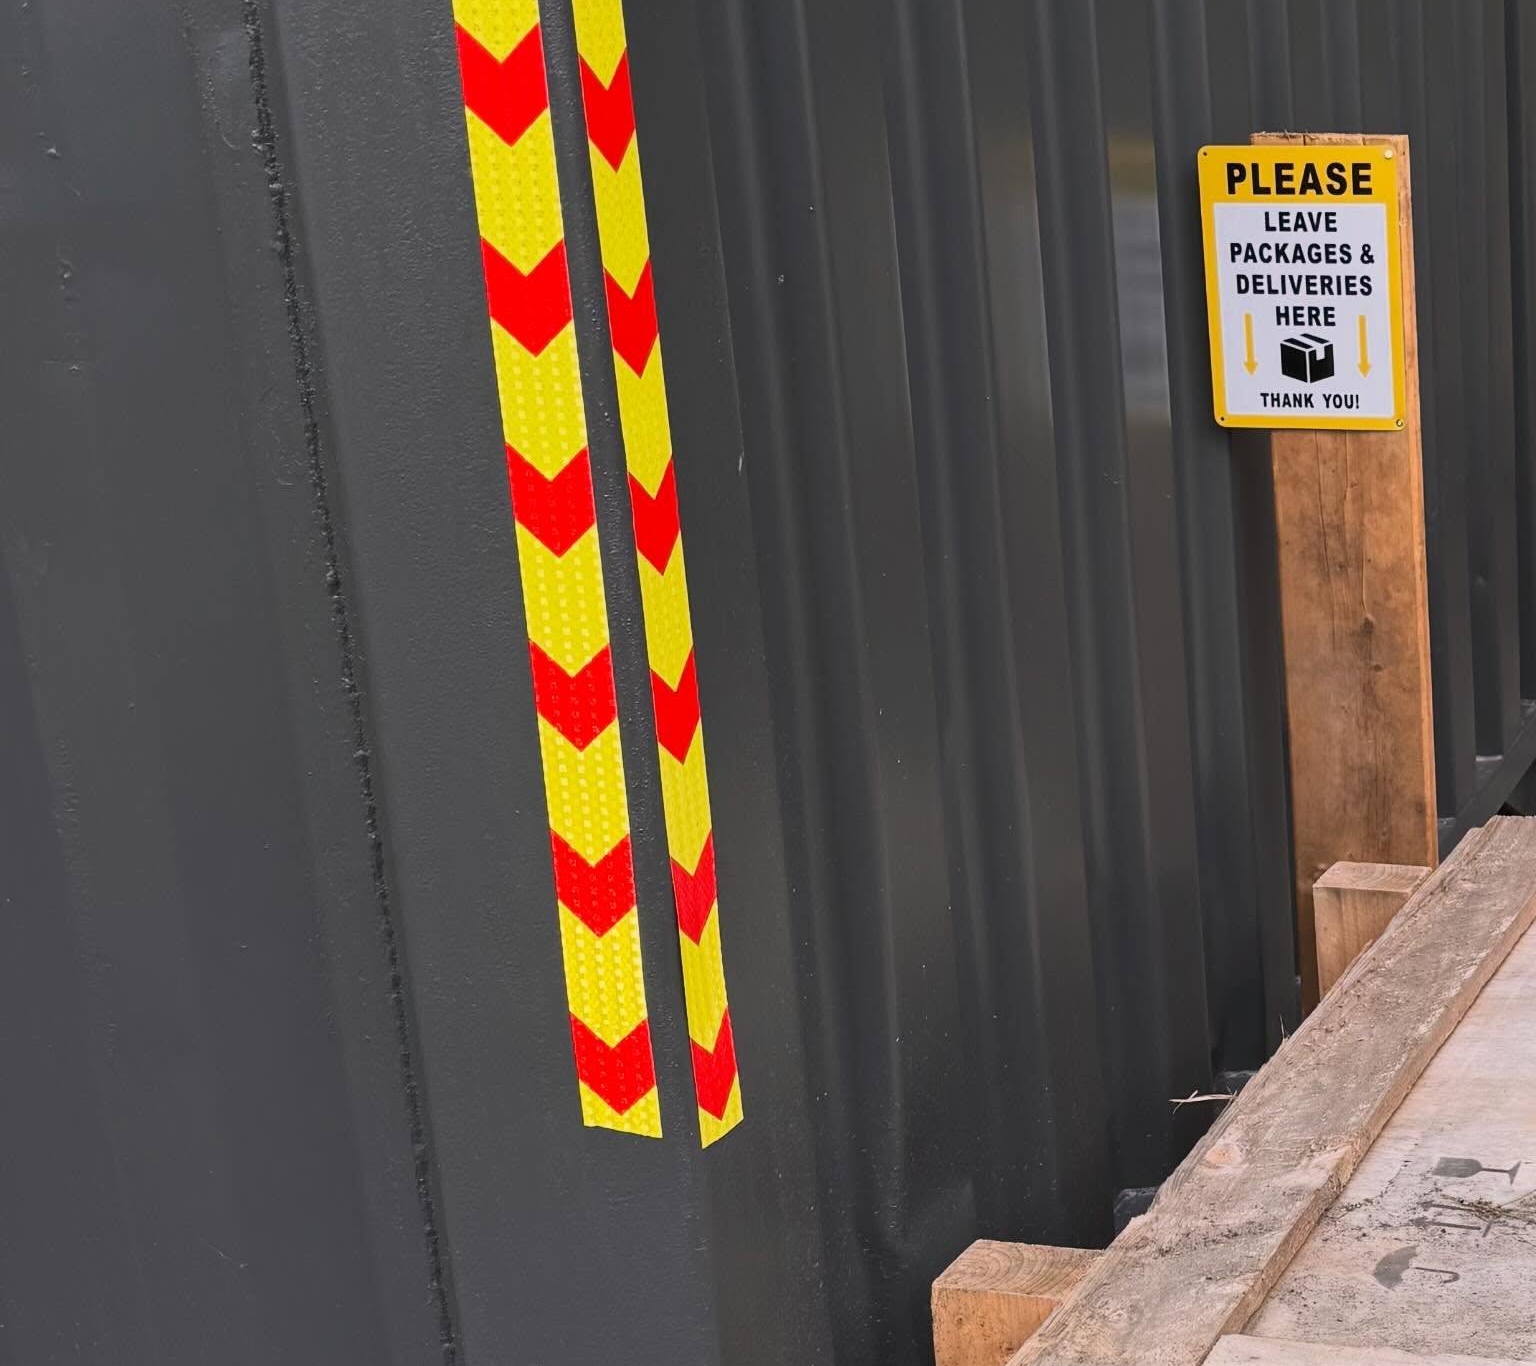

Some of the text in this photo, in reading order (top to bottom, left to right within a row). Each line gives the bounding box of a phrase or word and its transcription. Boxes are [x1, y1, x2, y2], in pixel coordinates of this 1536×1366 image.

[1226, 163, 1373, 196] PLEASE
[1264, 211, 1338, 233] LEAVE
[1230, 242, 1375, 264] PACKAGES &
[1236, 274, 1373, 296] DELIVERIES
[1275, 306, 1337, 327] HERE
[1260, 392, 1360, 409] THANK YOU!
